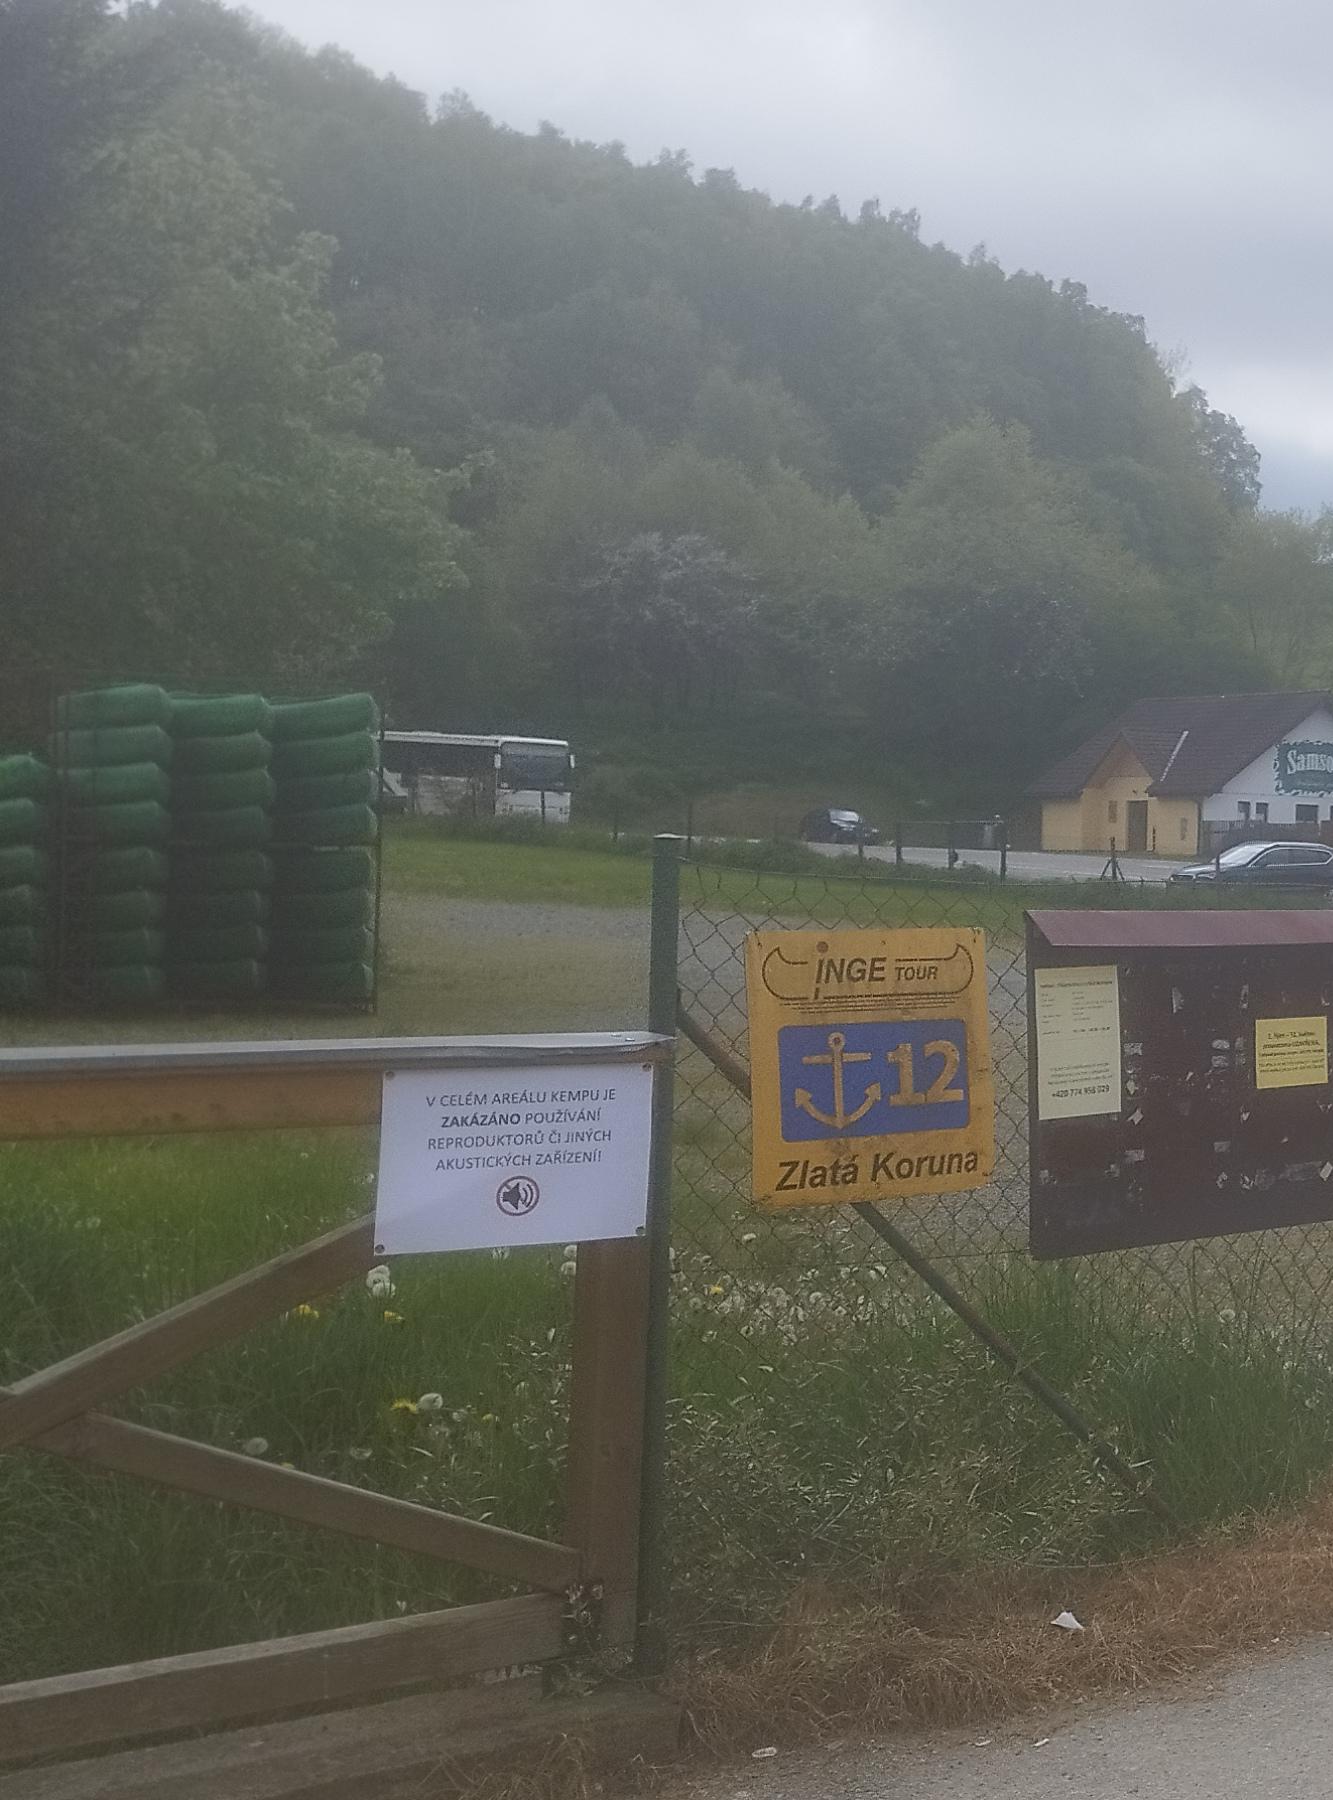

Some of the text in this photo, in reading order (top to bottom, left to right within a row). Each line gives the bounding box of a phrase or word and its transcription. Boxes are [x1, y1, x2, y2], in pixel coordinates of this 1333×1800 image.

[894, 966, 938, 981] TOUR
[887, 1040, 964, 1106] 12
[426, 1088, 616, 1107] V CELÉM AREÁLU KEMPU JE
[441, 1107, 601, 1129] ZAKÁZÁNO POUŽÍVÁNÍ
[427, 1128, 612, 1150] REPRODUKTORŮ ČI JINÝCH
[435, 1153, 531, 1171] AKUSTICKÝCH
[775, 1150, 978, 1192] Zlatá Koruna
